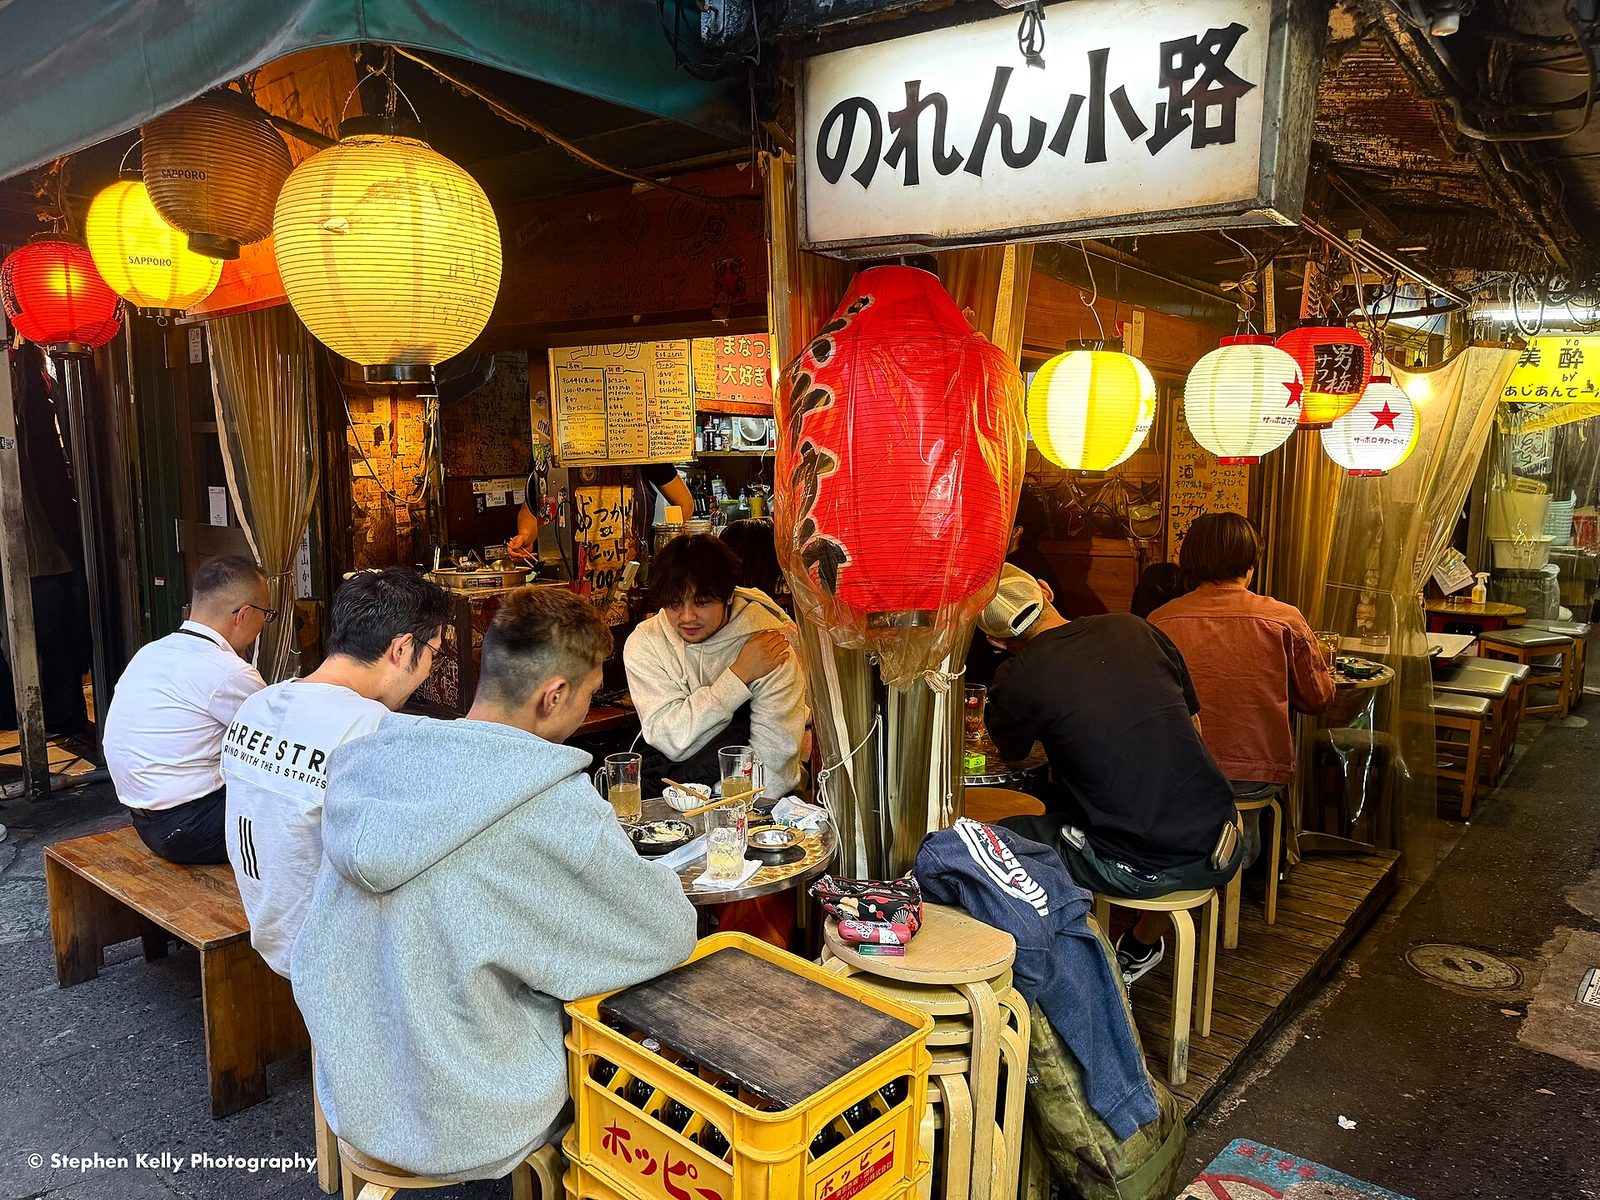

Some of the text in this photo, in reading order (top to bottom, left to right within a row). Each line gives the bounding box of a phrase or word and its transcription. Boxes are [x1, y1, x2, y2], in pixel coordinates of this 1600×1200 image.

[816, 22, 1257, 190] のれん小路
[161, 168, 206, 181] SAPPORO
[128, 255, 172, 267] SAPPORO
[722, 363, 766, 388] 大好き
[1178, 464, 1194, 479] 酒
[240, 752, 260, 767] WITH
[261, 760, 273, 772] THE
[275, 766, 280, 775] 3
[283, 769, 327, 790] STRIPES
[819, 1140, 891, 1200] ホッピー
